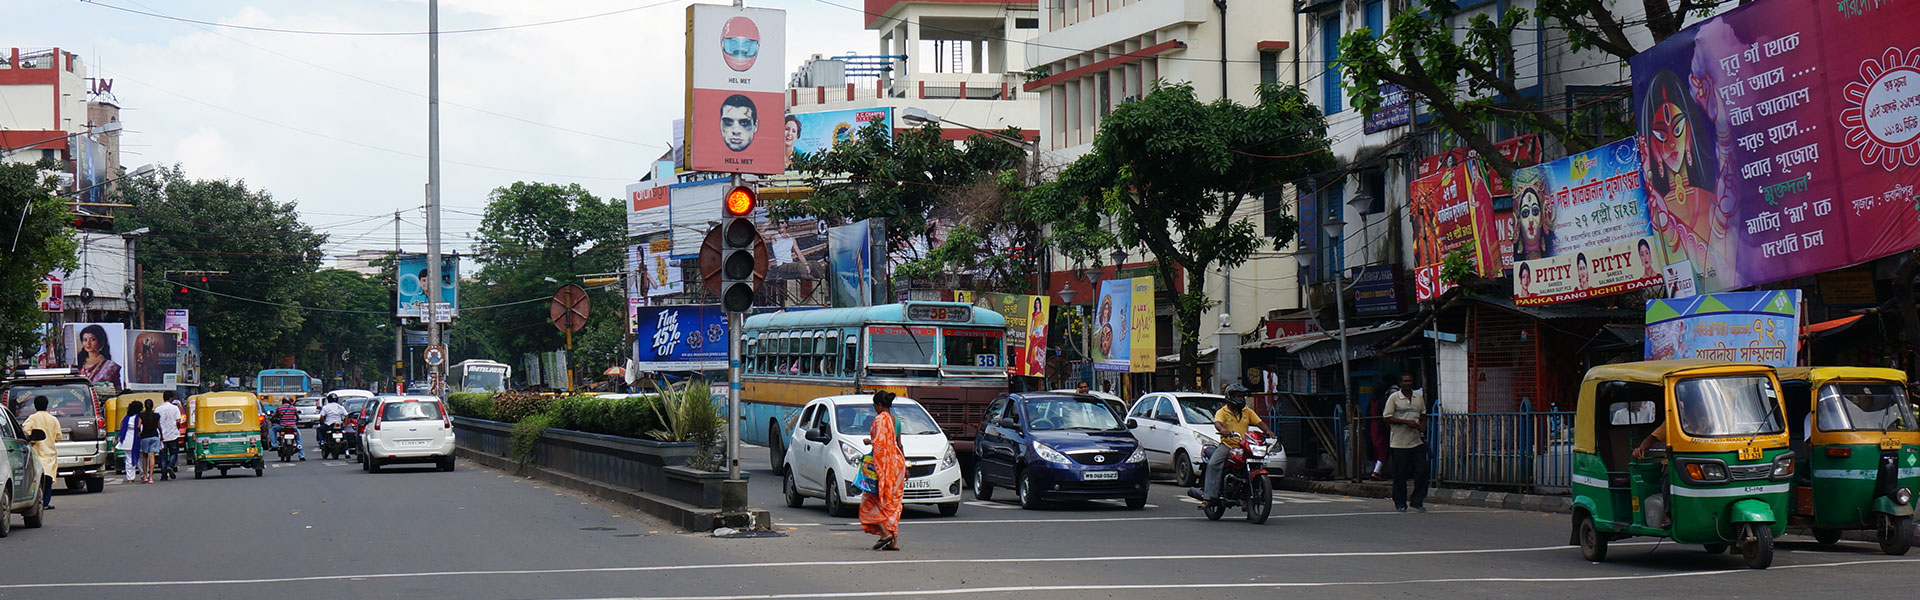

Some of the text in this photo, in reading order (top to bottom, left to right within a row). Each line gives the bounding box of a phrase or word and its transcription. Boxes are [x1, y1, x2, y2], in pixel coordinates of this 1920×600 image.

[1719, 32, 1800, 76] দূর গাঁ থেকে
[1719, 78, 1744, 105] দুর্গা
[1747, 66, 1784, 91] আসে
[1729, 87, 1810, 127] নীল আকাশে
[1737, 132, 1764, 152] শরৎ
[1740, 158, 1771, 180] এবার
[1745, 210, 1781, 235] মাটির
[1812, 198, 1832, 217] কে
[1761, 230, 1824, 258] দেখবি চল
[1536, 264, 1571, 283] PITTY
[1592, 252, 1632, 273] PITTY
[1516, 297, 1553, 306] PAKKA
[1556, 292, 1587, 301] RANG
[1590, 285, 1623, 297] UCHIT
[1627, 277, 1663, 289] DAAM
[657, 309, 678, 329] Flat
[930, 308, 946, 319] 3B
[652, 322, 680, 348] 15%
[1753, 318, 1776, 344] ৭২
[978, 355, 995, 367] 3B
